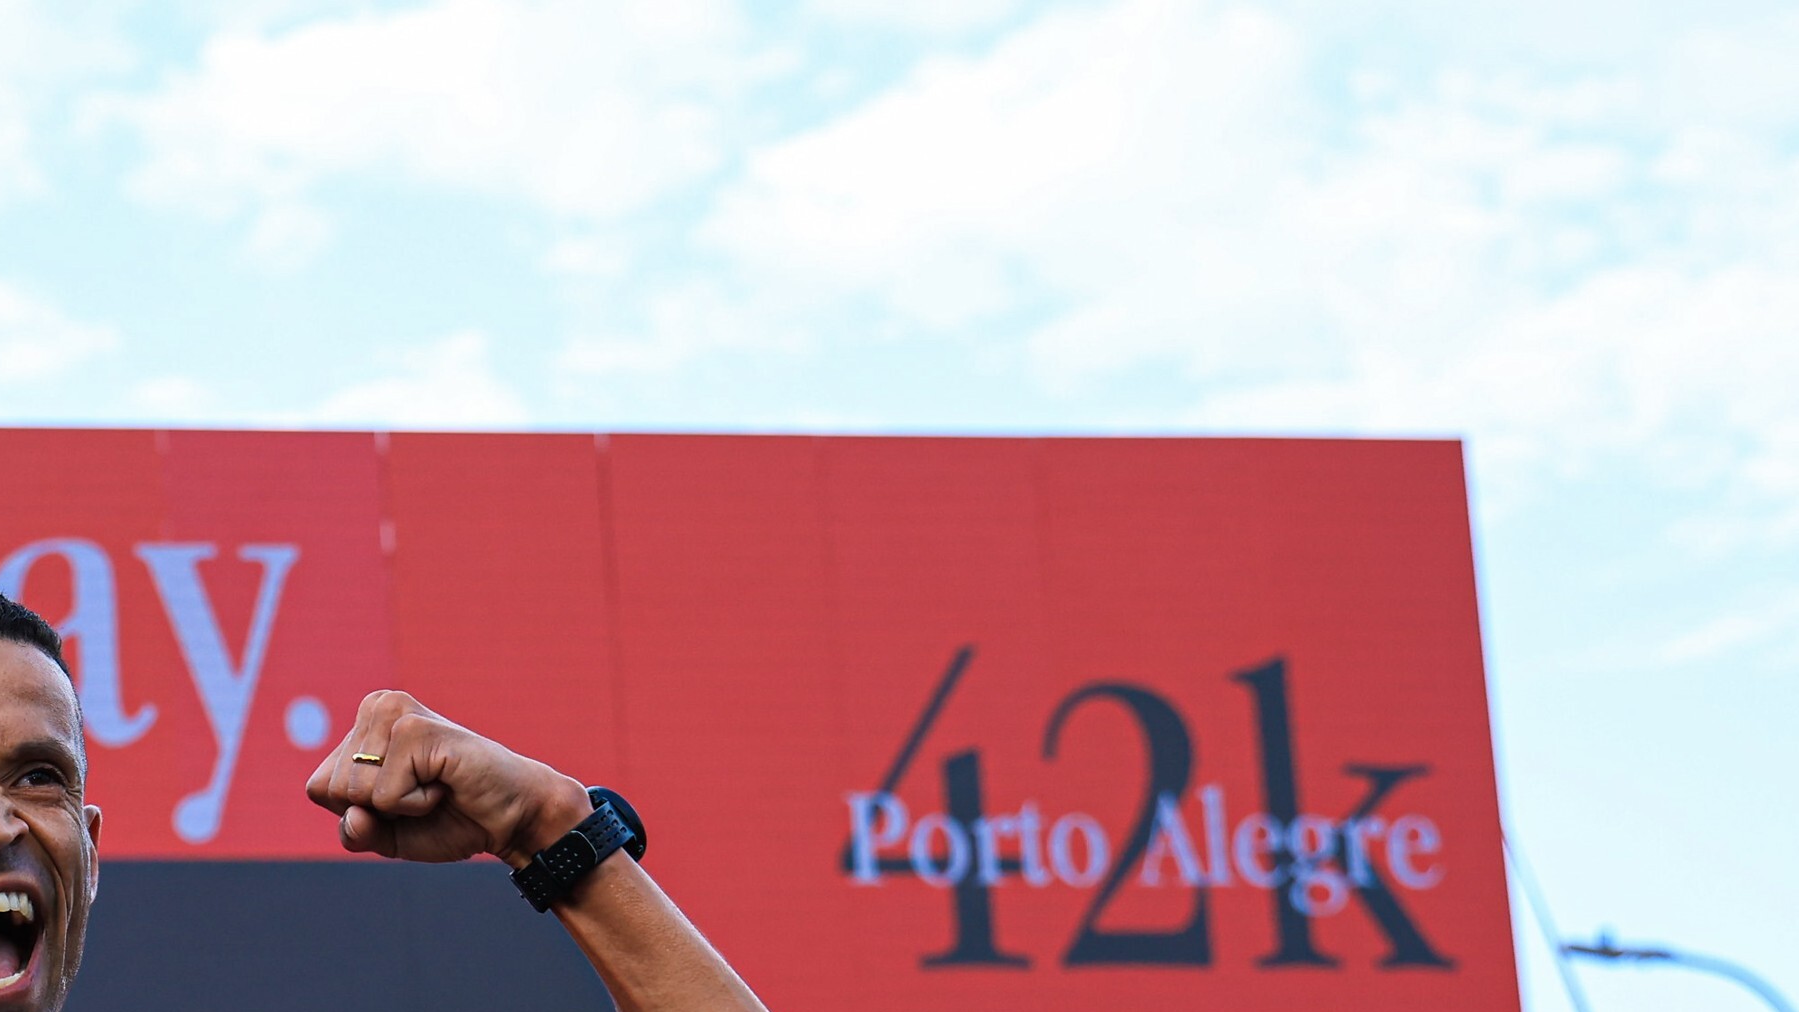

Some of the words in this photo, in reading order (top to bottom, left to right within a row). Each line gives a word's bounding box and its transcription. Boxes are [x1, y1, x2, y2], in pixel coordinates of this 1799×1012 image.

[841, 643, 1458, 972] 42k
[845, 789, 1110, 888] Porto
[1140, 784, 1445, 917] Alegre
